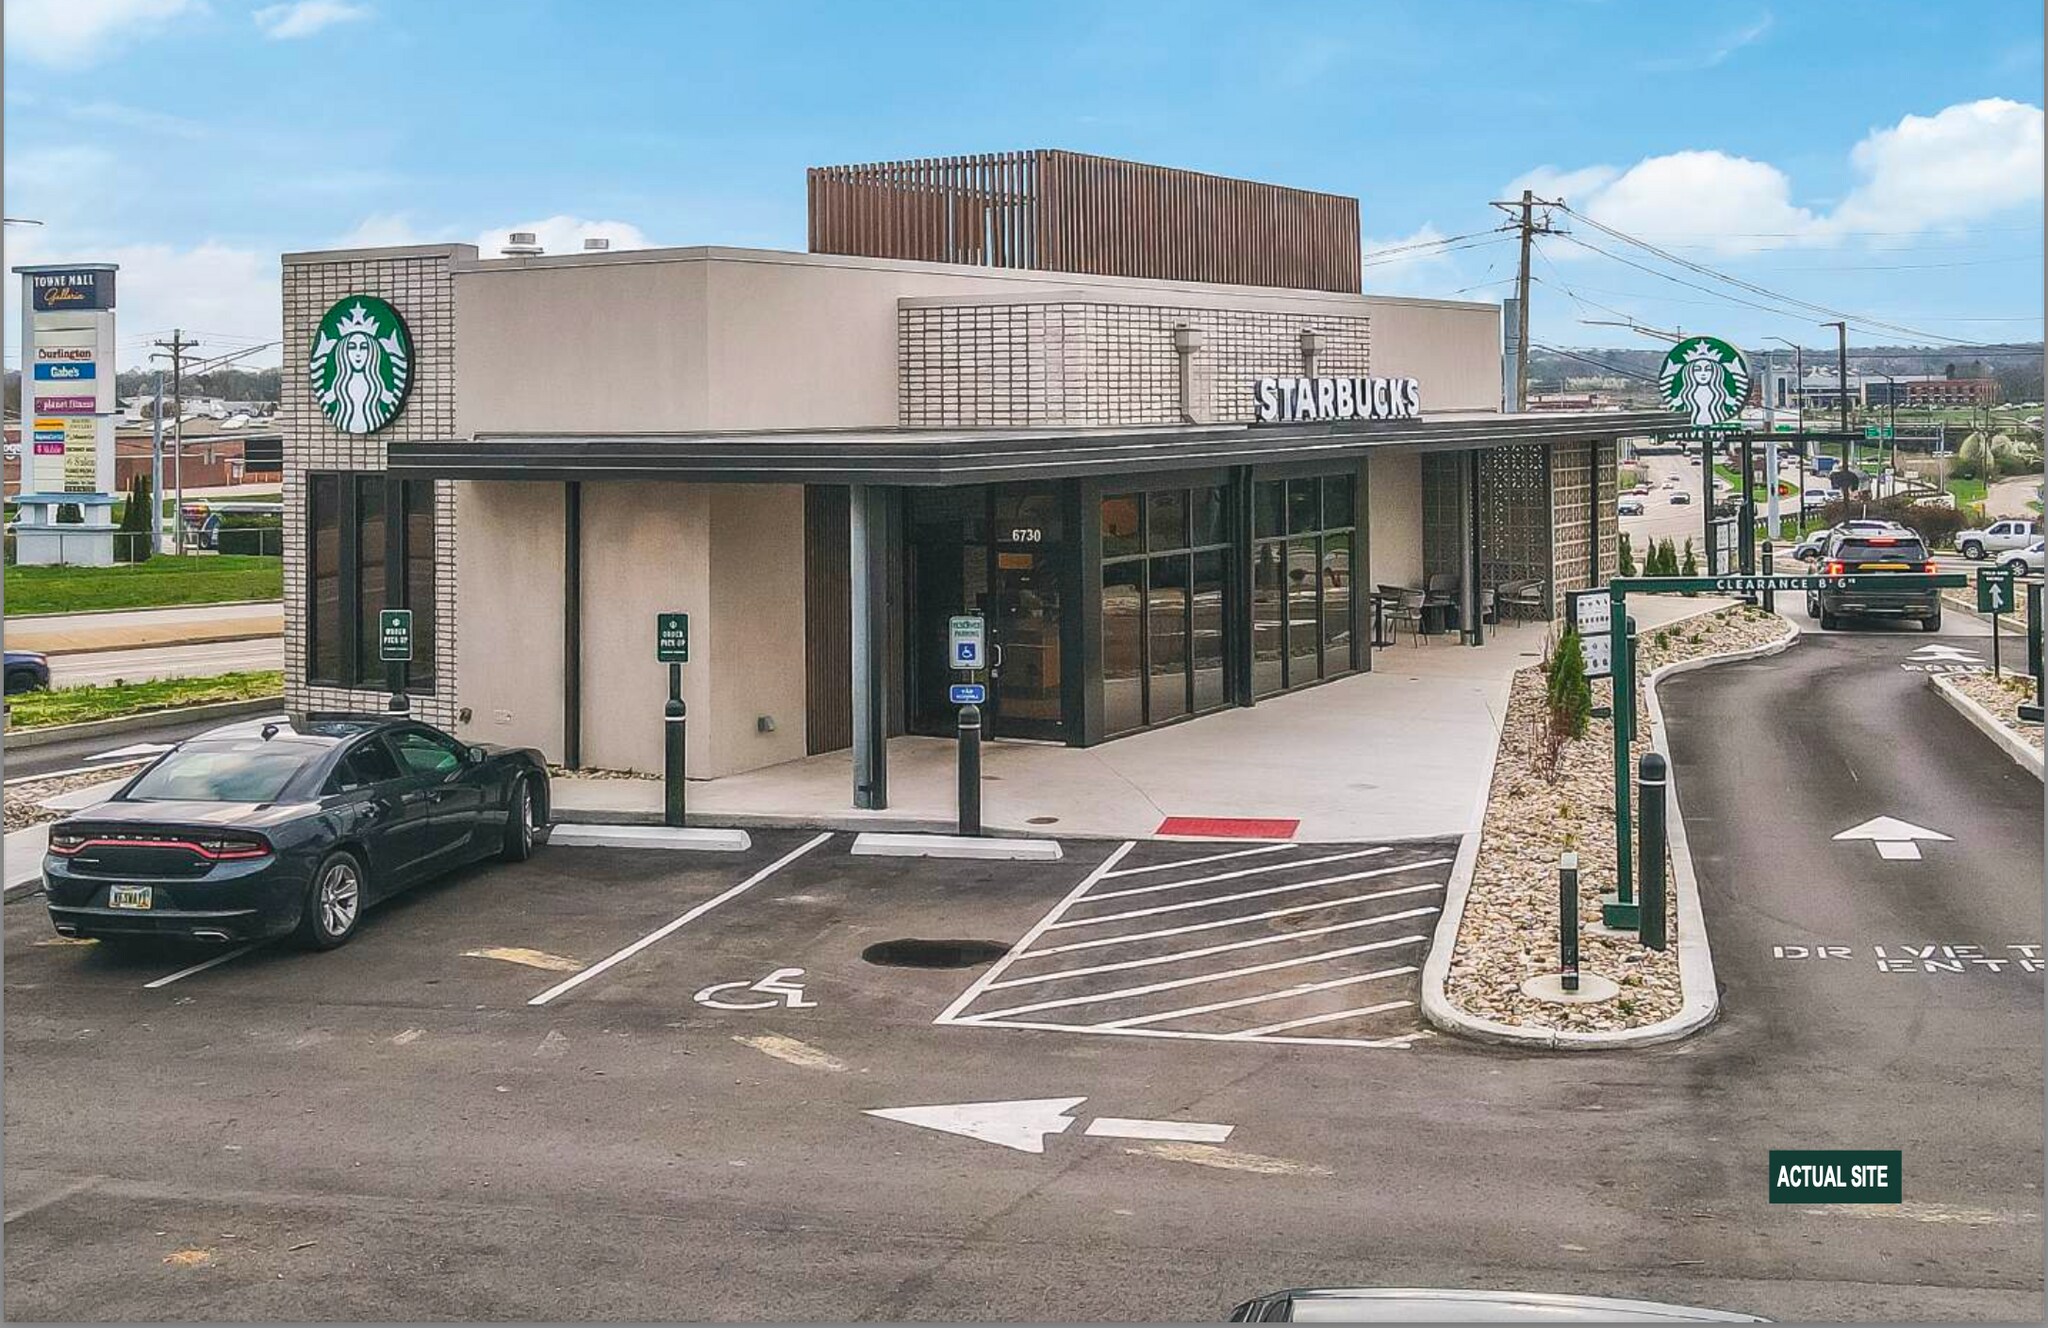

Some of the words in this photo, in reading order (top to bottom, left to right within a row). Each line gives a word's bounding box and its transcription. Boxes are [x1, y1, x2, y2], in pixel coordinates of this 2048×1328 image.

[34, 275, 66, 287] TOWNE
[68, 274, 94, 286] MALL
[1255, 377, 1420, 421] STARBUCKS
[1012, 528, 1042, 542] 6730
[1716, 579, 1808, 590] CLEARANCE
